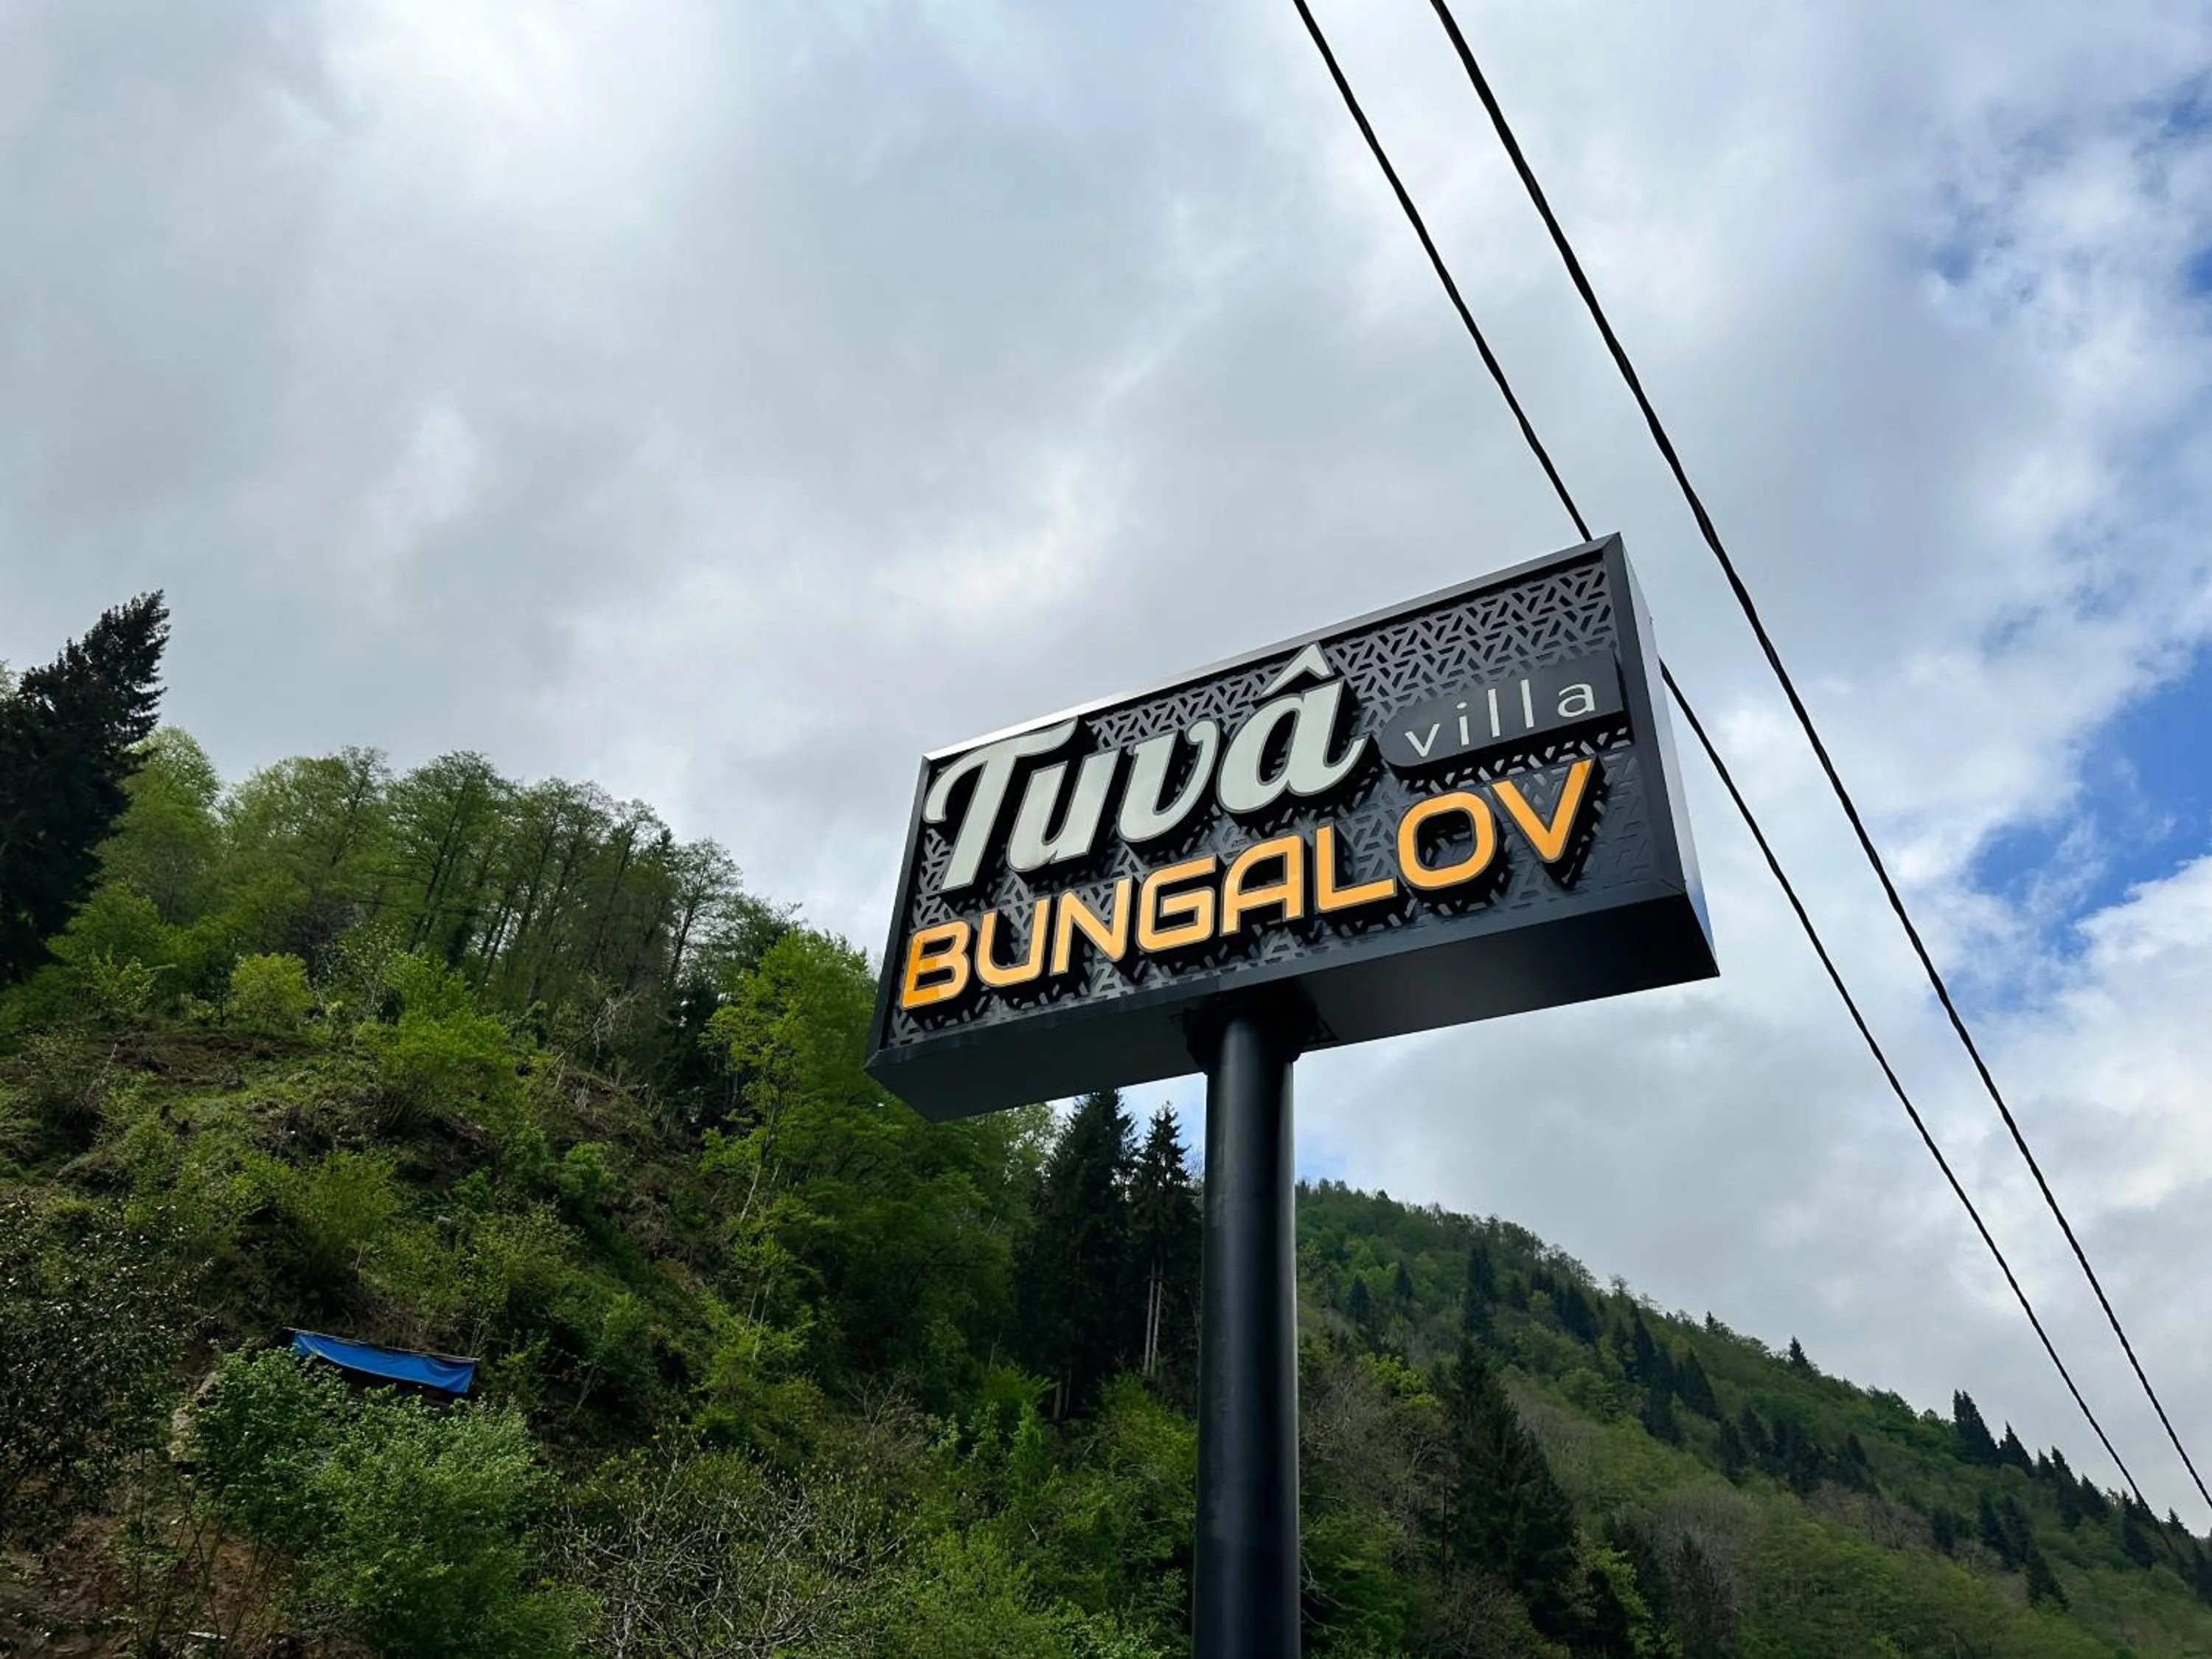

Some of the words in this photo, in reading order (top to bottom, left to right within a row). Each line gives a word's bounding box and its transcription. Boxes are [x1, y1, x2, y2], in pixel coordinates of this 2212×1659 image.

[900, 758, 1593, 1009] BUNGALOV
[924, 643, 1368, 893] Tuvâ
[1405, 678, 1596, 758] villa
